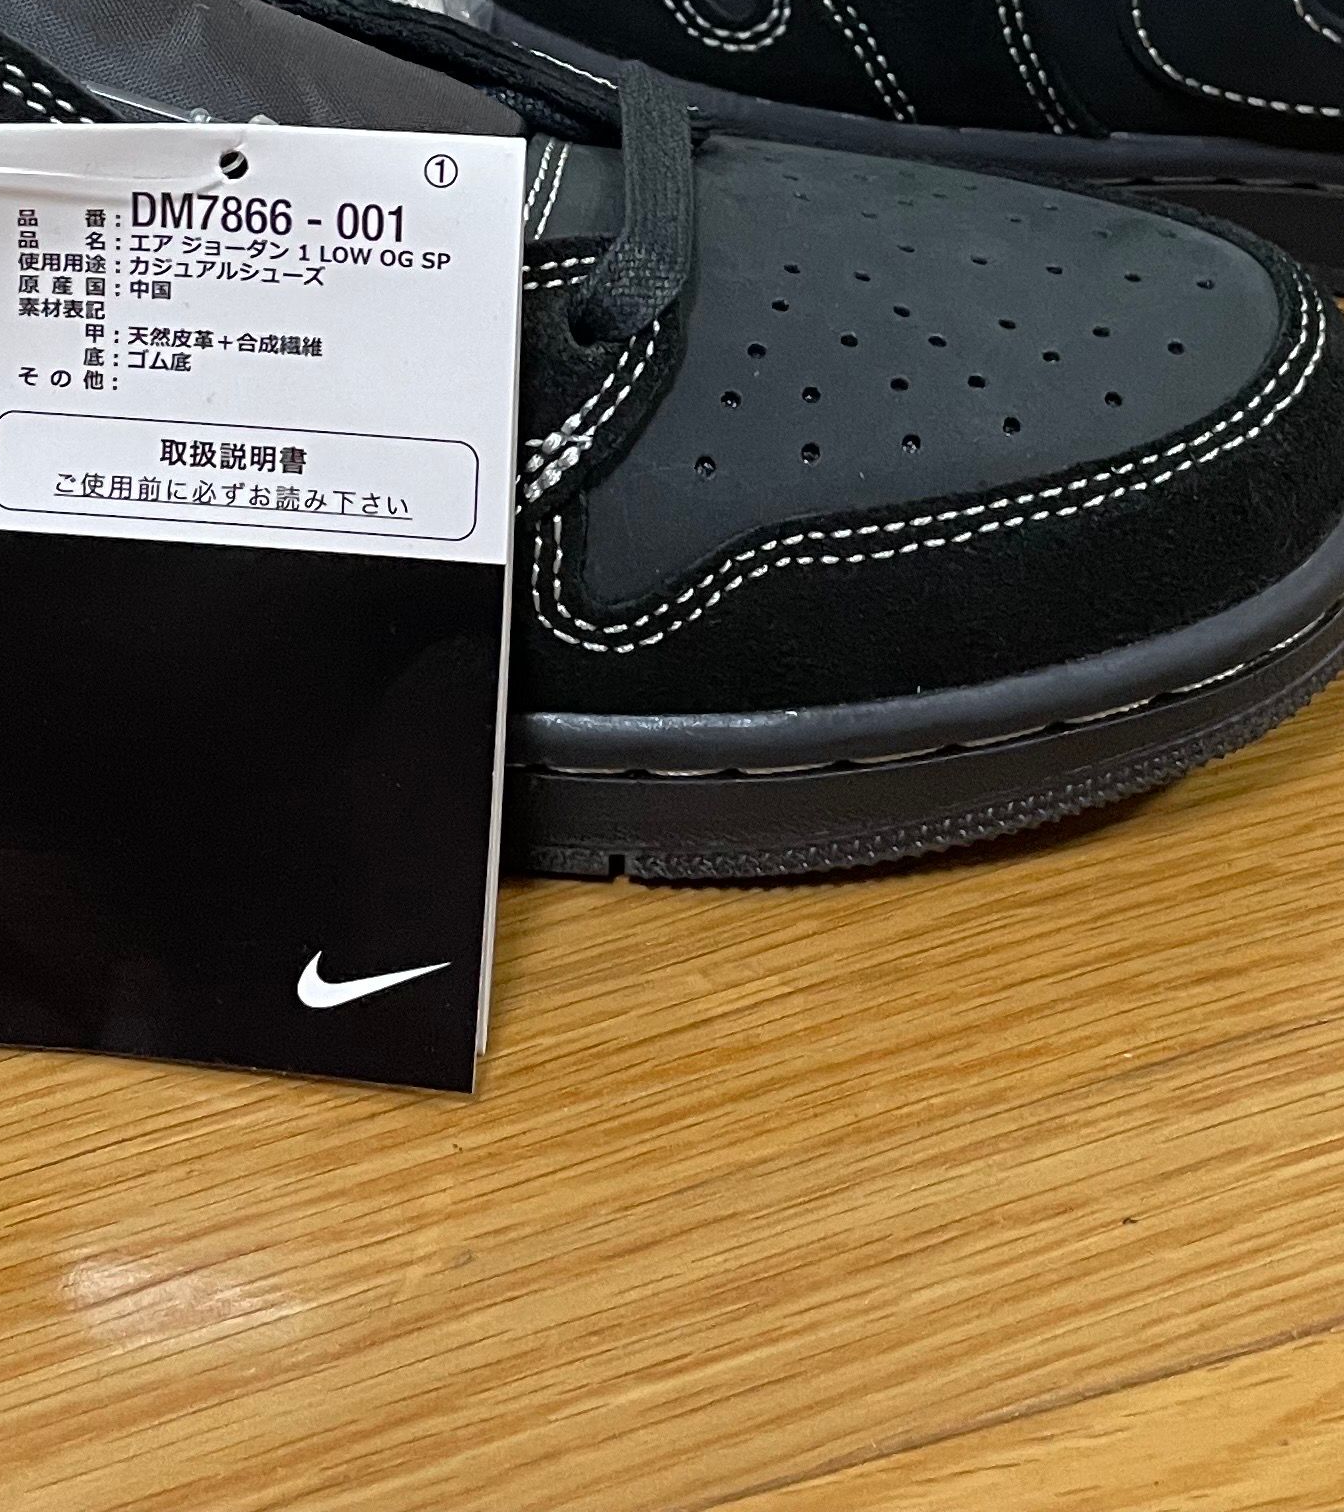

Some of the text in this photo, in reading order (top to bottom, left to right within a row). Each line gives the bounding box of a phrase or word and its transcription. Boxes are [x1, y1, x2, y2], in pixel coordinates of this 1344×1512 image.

[319, 245, 373, 265] LOW
[380, 249, 414, 268] OG
[421, 251, 452, 270] SP
[18, 298, 106, 320] 素材表記
[159, 438, 308, 475] 取扱説明書
[54, 472, 409, 517] ご使用前に必ずお読み下さい
